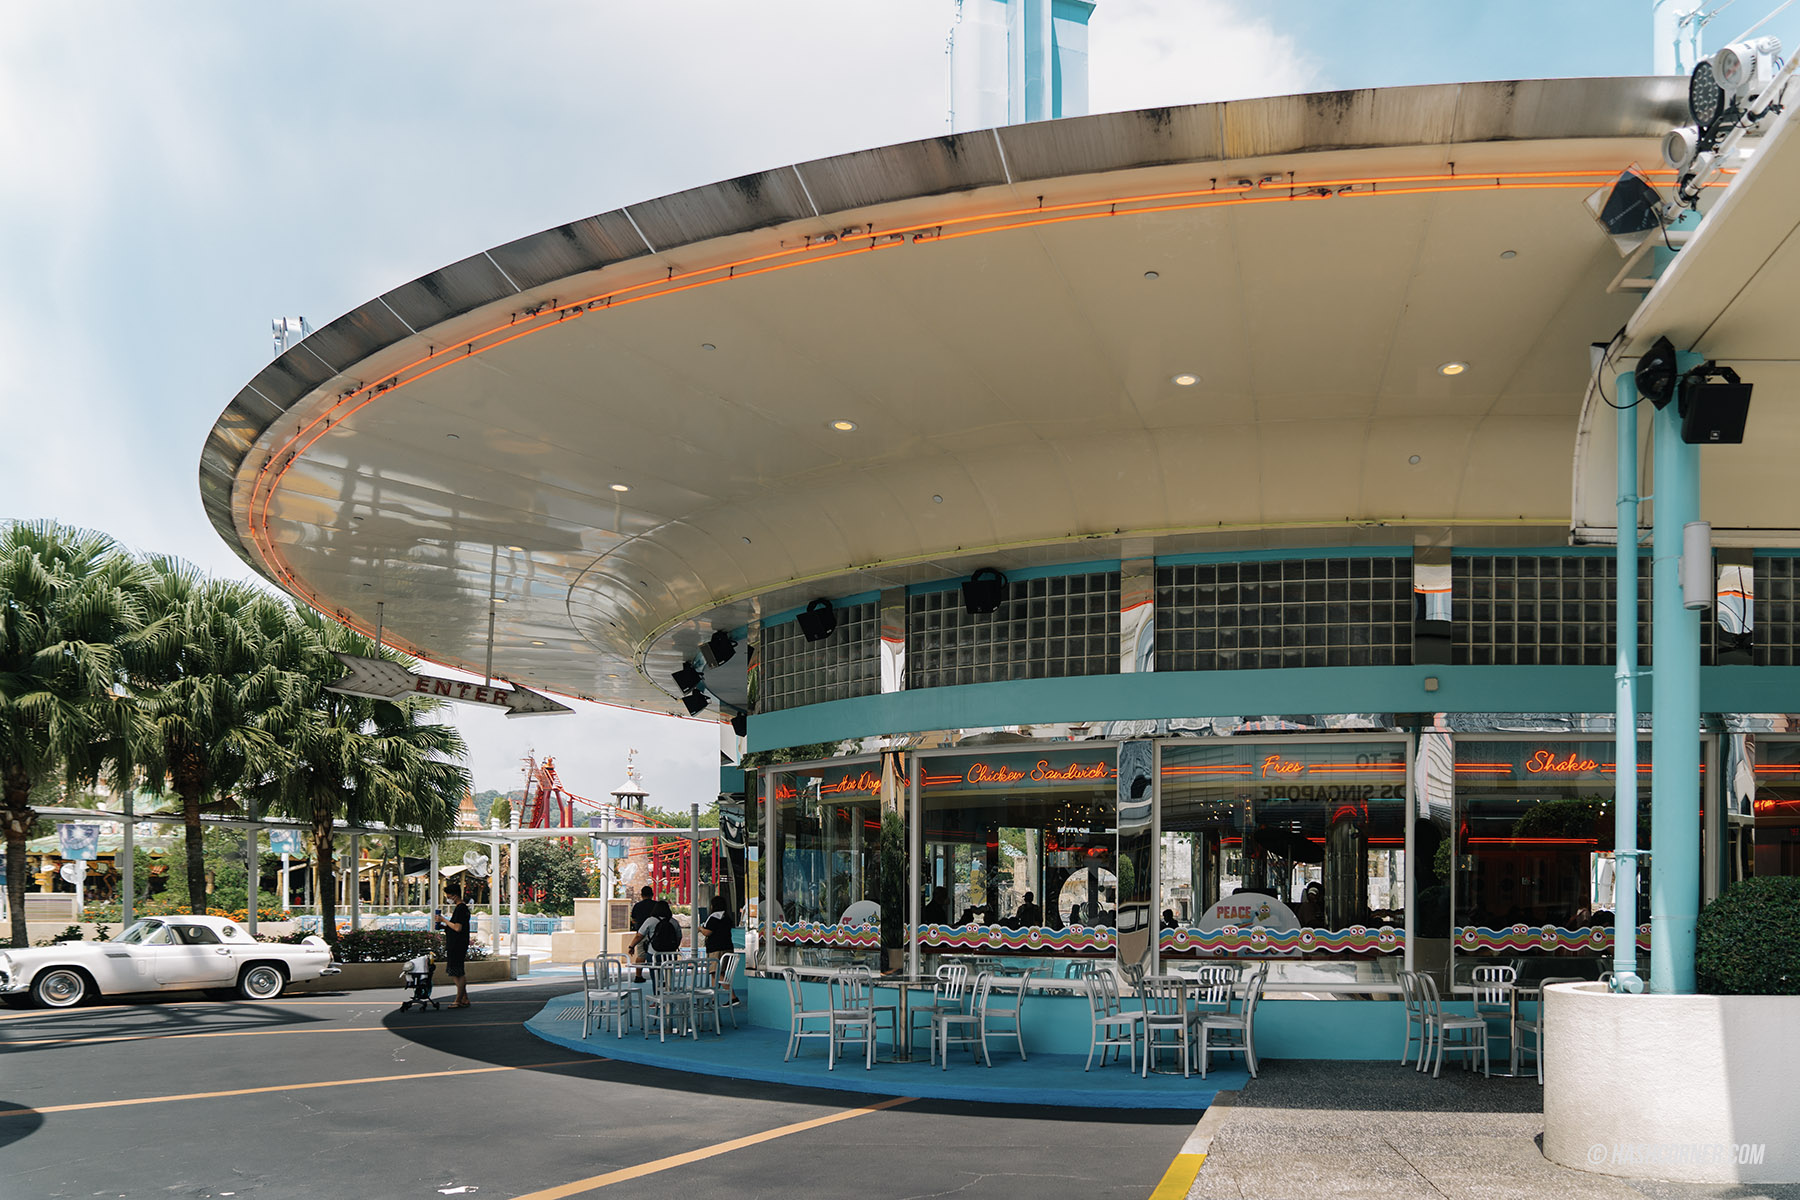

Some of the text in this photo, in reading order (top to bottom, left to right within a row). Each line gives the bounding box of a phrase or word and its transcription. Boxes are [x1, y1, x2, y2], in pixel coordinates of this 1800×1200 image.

[416, 677, 509, 705] ENTER
[967, 759, 1108, 784] Chicken Sandwich
[1260, 754, 1305, 779] Fries
[1525, 750, 1599, 773] Shakes
[1216, 906, 1252, 919] PEACE
